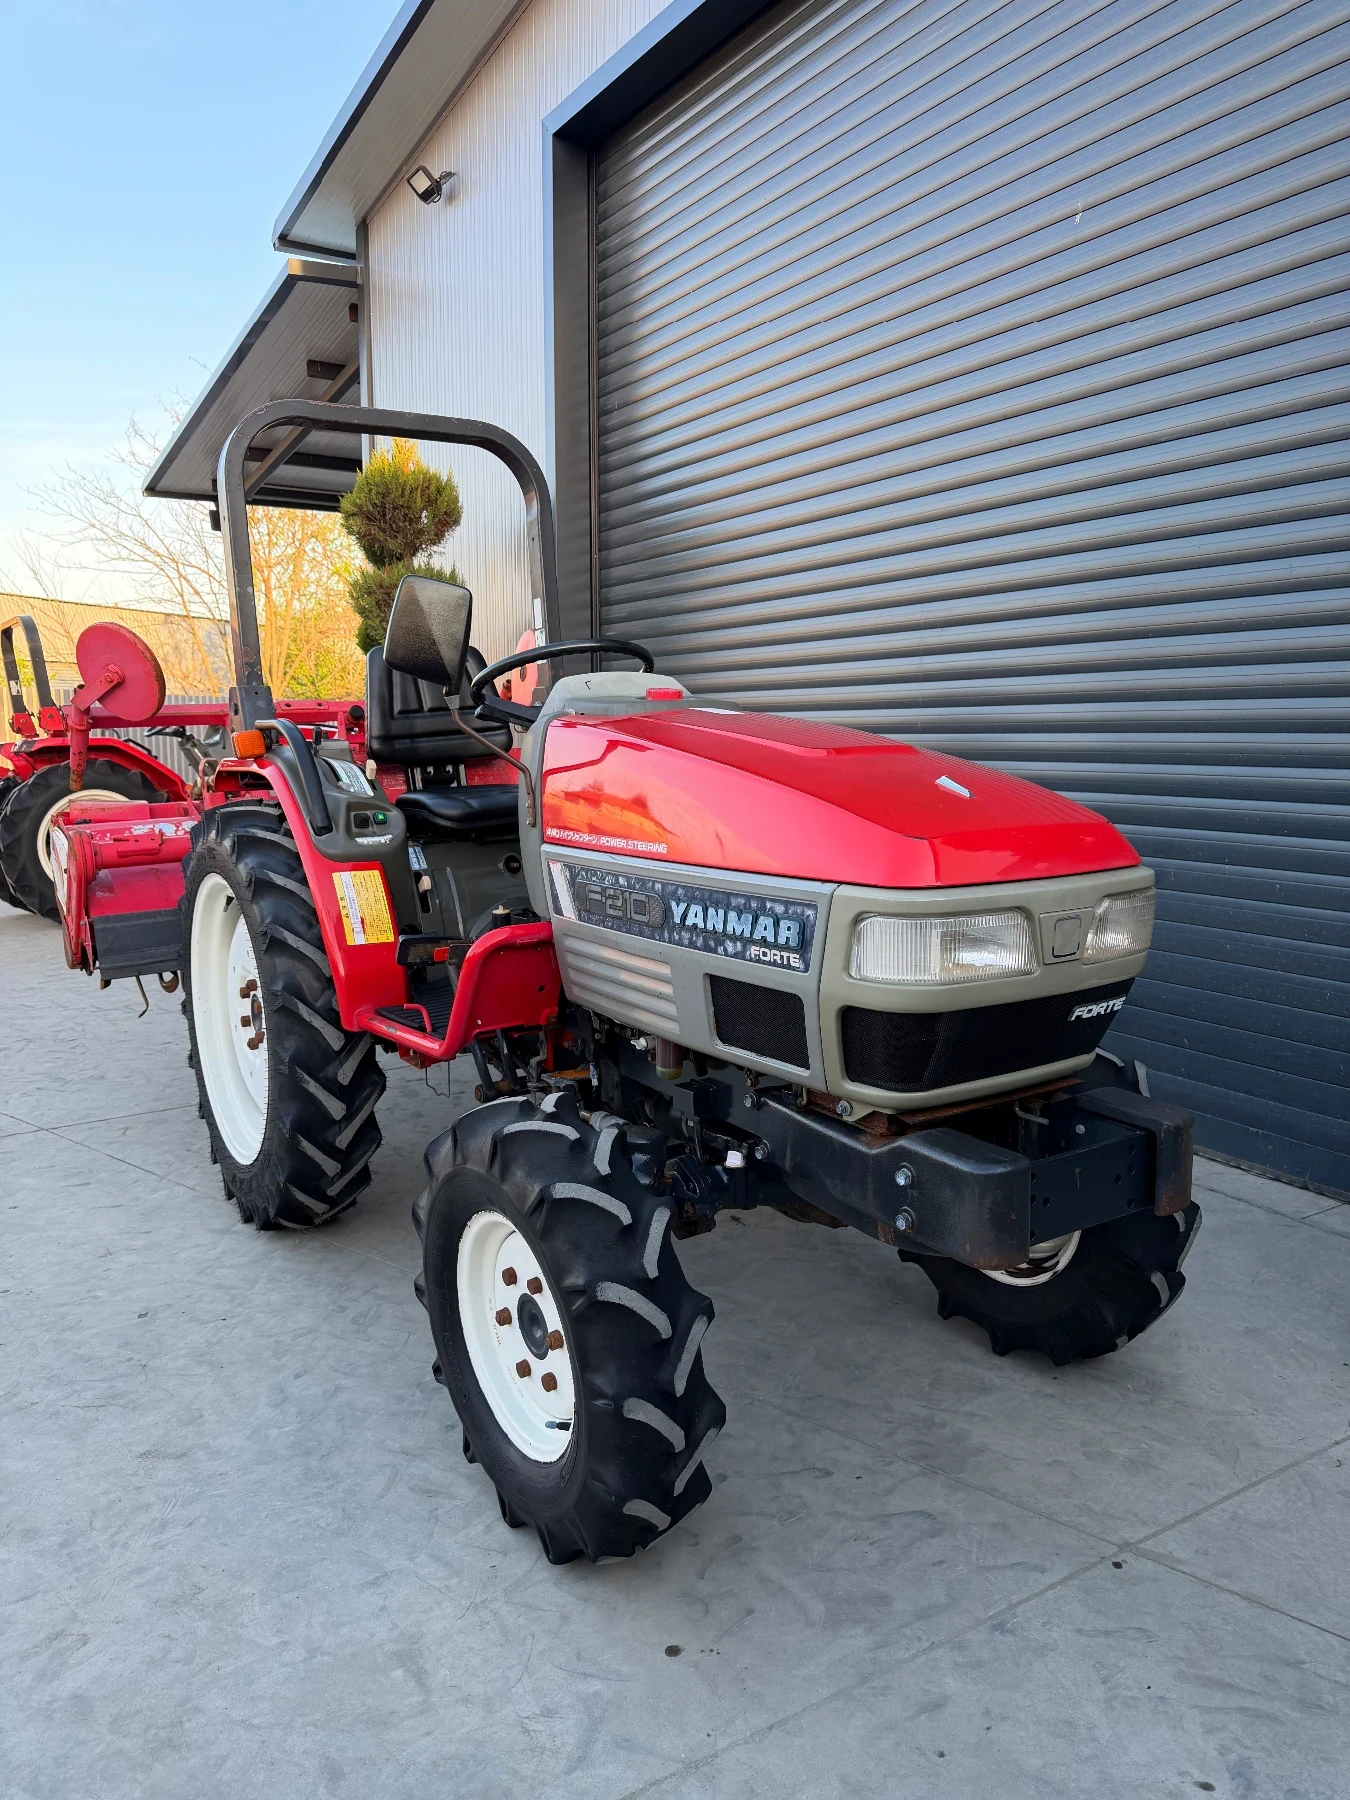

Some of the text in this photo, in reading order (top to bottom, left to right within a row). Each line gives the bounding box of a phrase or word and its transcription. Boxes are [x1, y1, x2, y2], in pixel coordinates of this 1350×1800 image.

[600, 836, 627, 849] POWER
[627, 840, 668, 855] STEERING
[669, 900, 801, 948] YANMAR
[750, 945, 800, 968] FORTE
[1070, 996, 1127, 1021] FORTE
